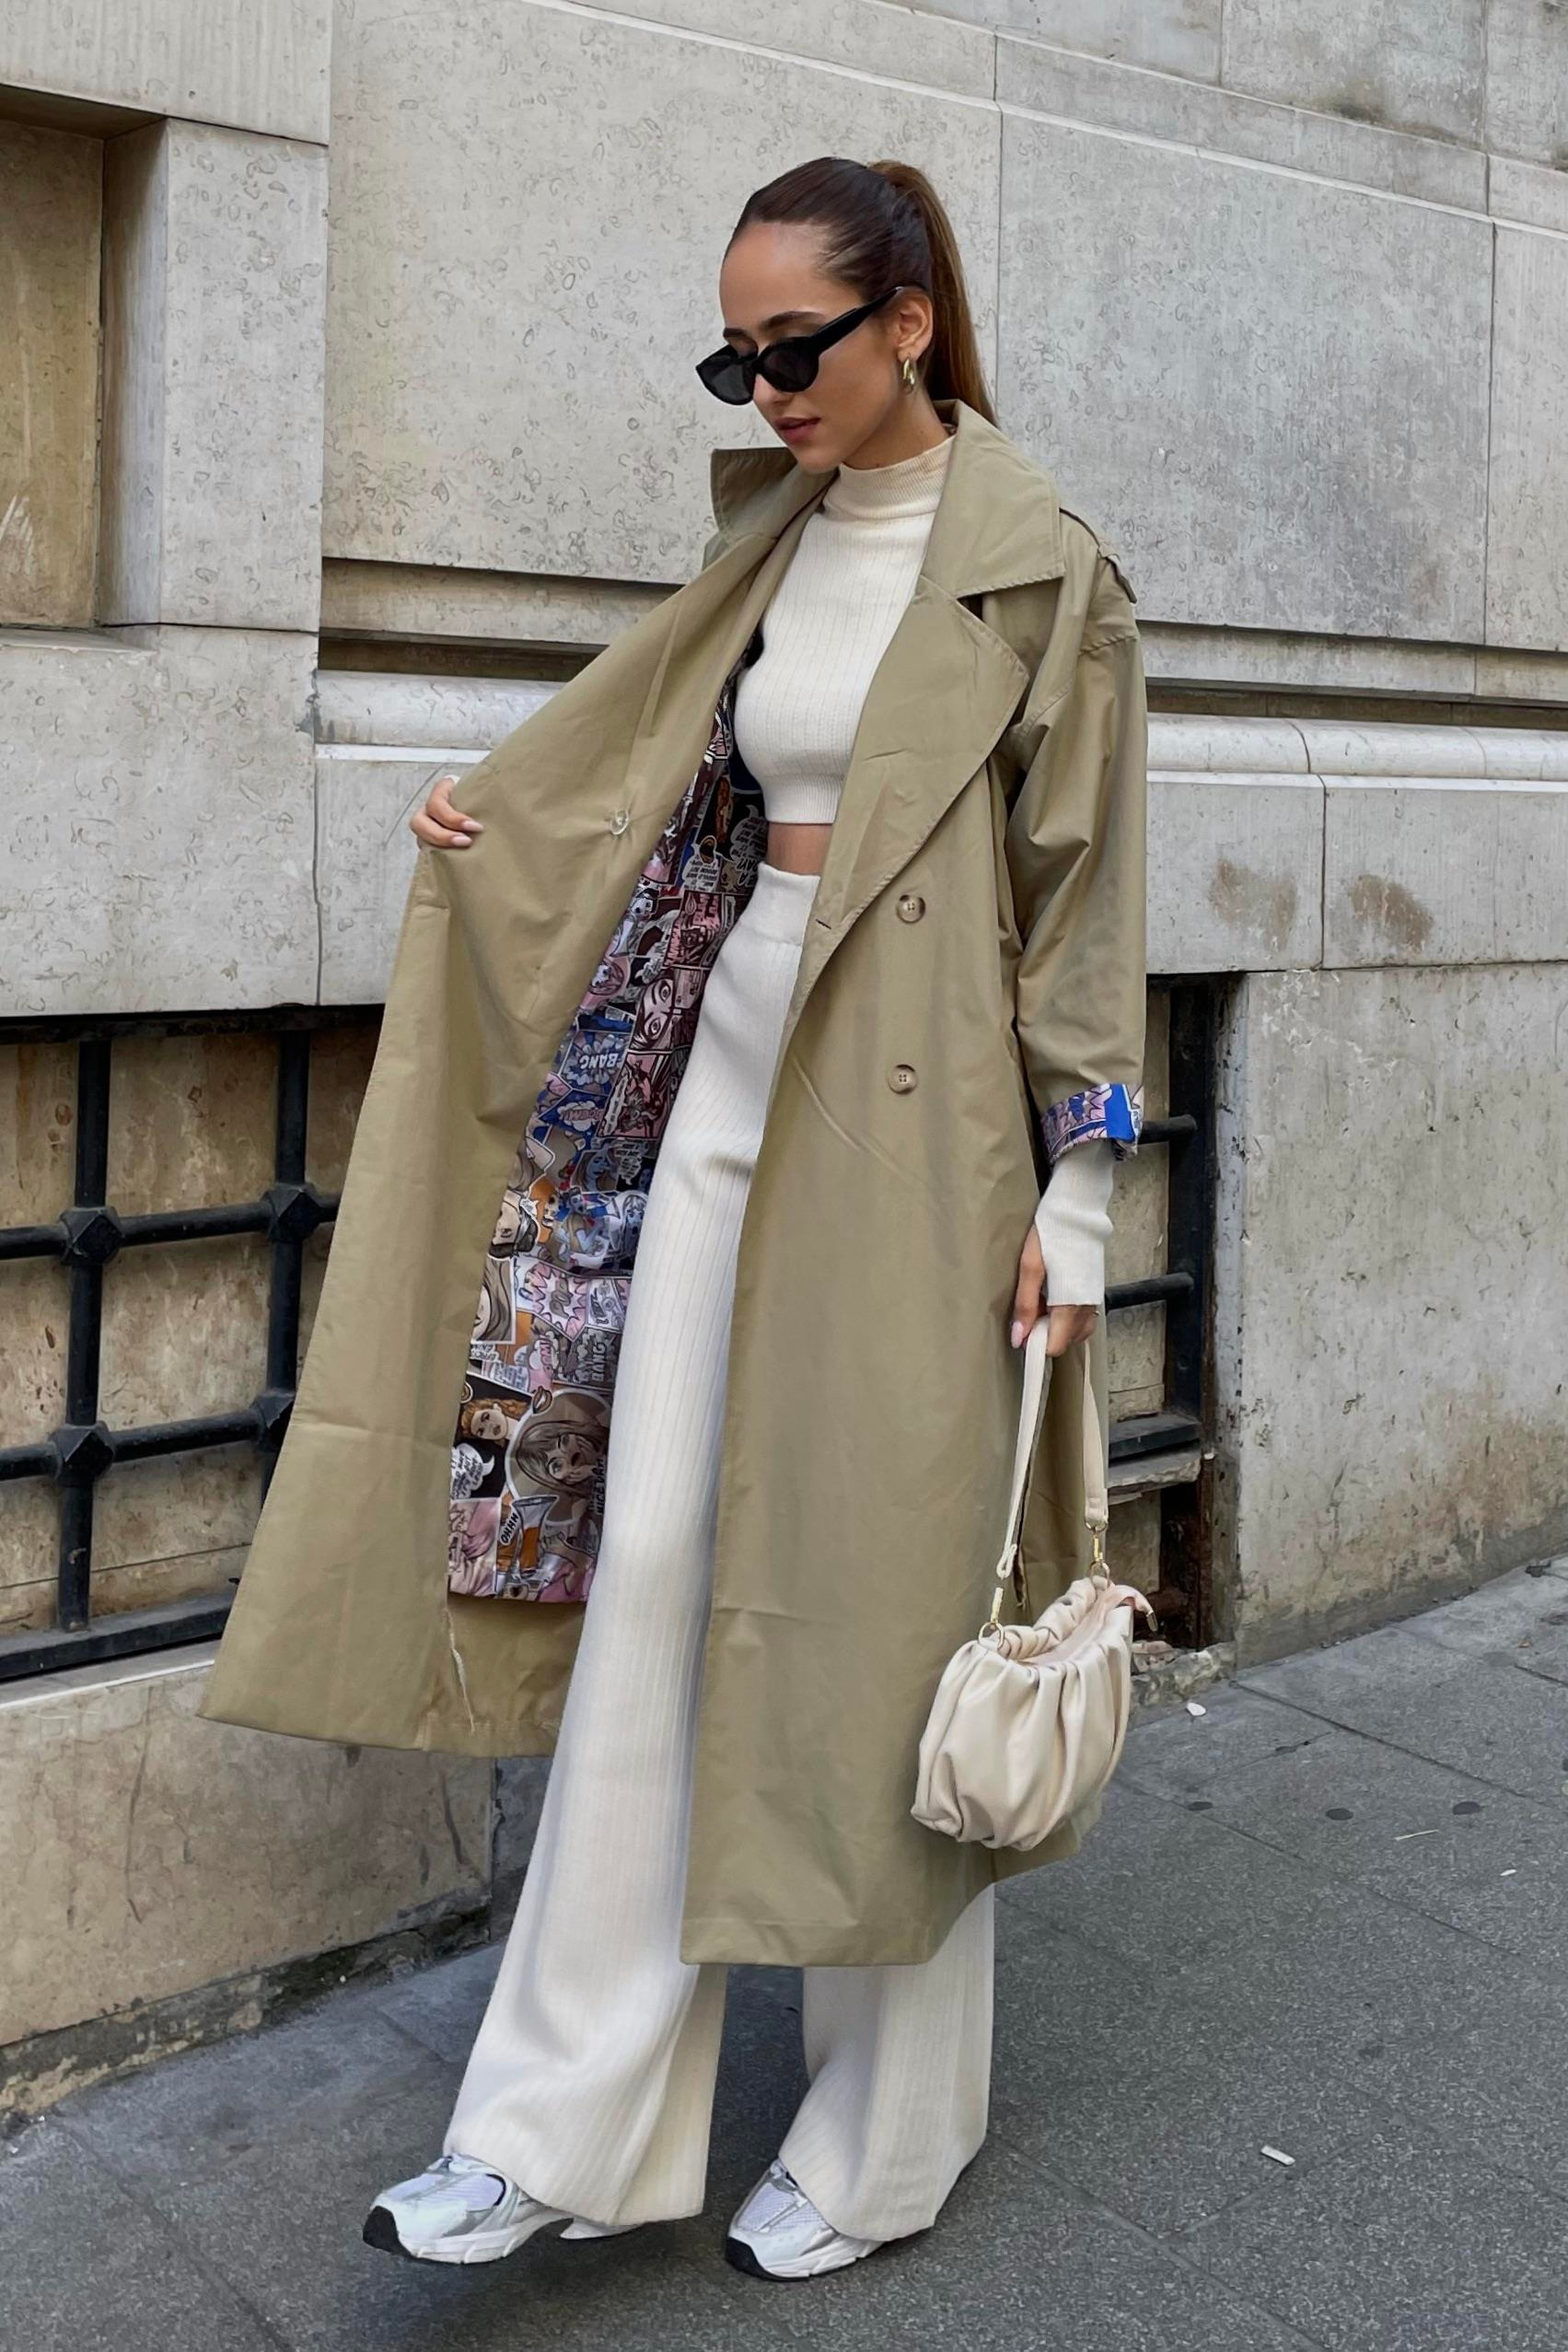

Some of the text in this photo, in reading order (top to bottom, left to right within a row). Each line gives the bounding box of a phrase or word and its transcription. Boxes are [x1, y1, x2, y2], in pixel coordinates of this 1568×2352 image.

[579, 1053, 619, 1069] BANG
[592, 1343, 606, 1381] BANG
[500, 1513, 519, 1543] OHHH
